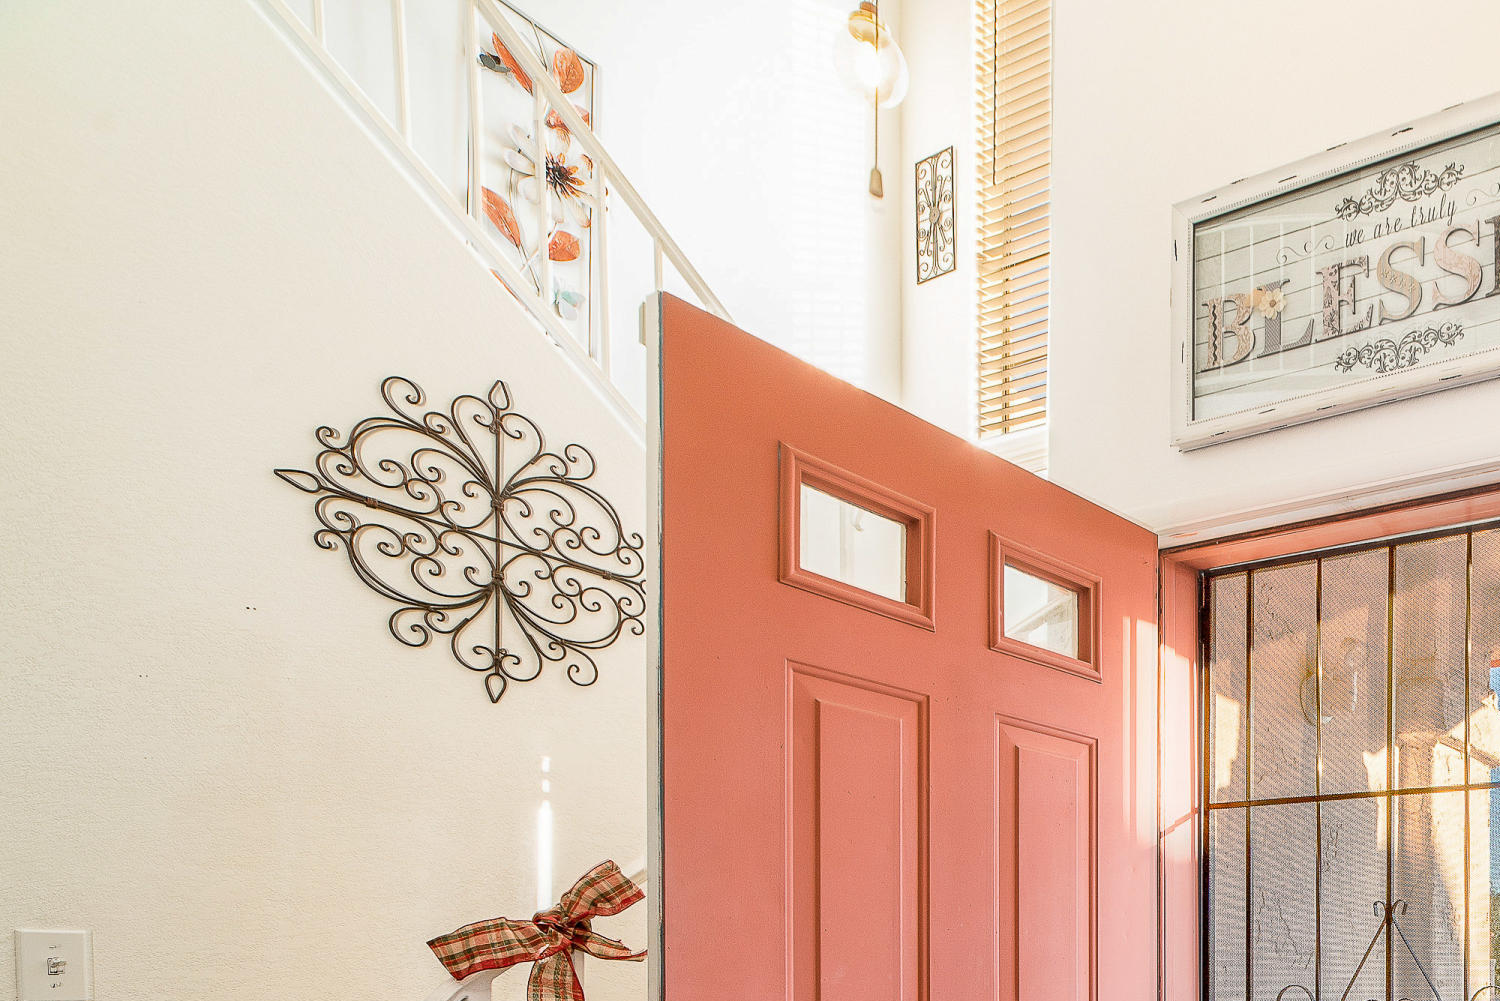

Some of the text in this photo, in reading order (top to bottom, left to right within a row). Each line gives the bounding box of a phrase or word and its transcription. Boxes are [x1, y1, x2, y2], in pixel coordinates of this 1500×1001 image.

[1345, 193, 1457, 248] we are truly
